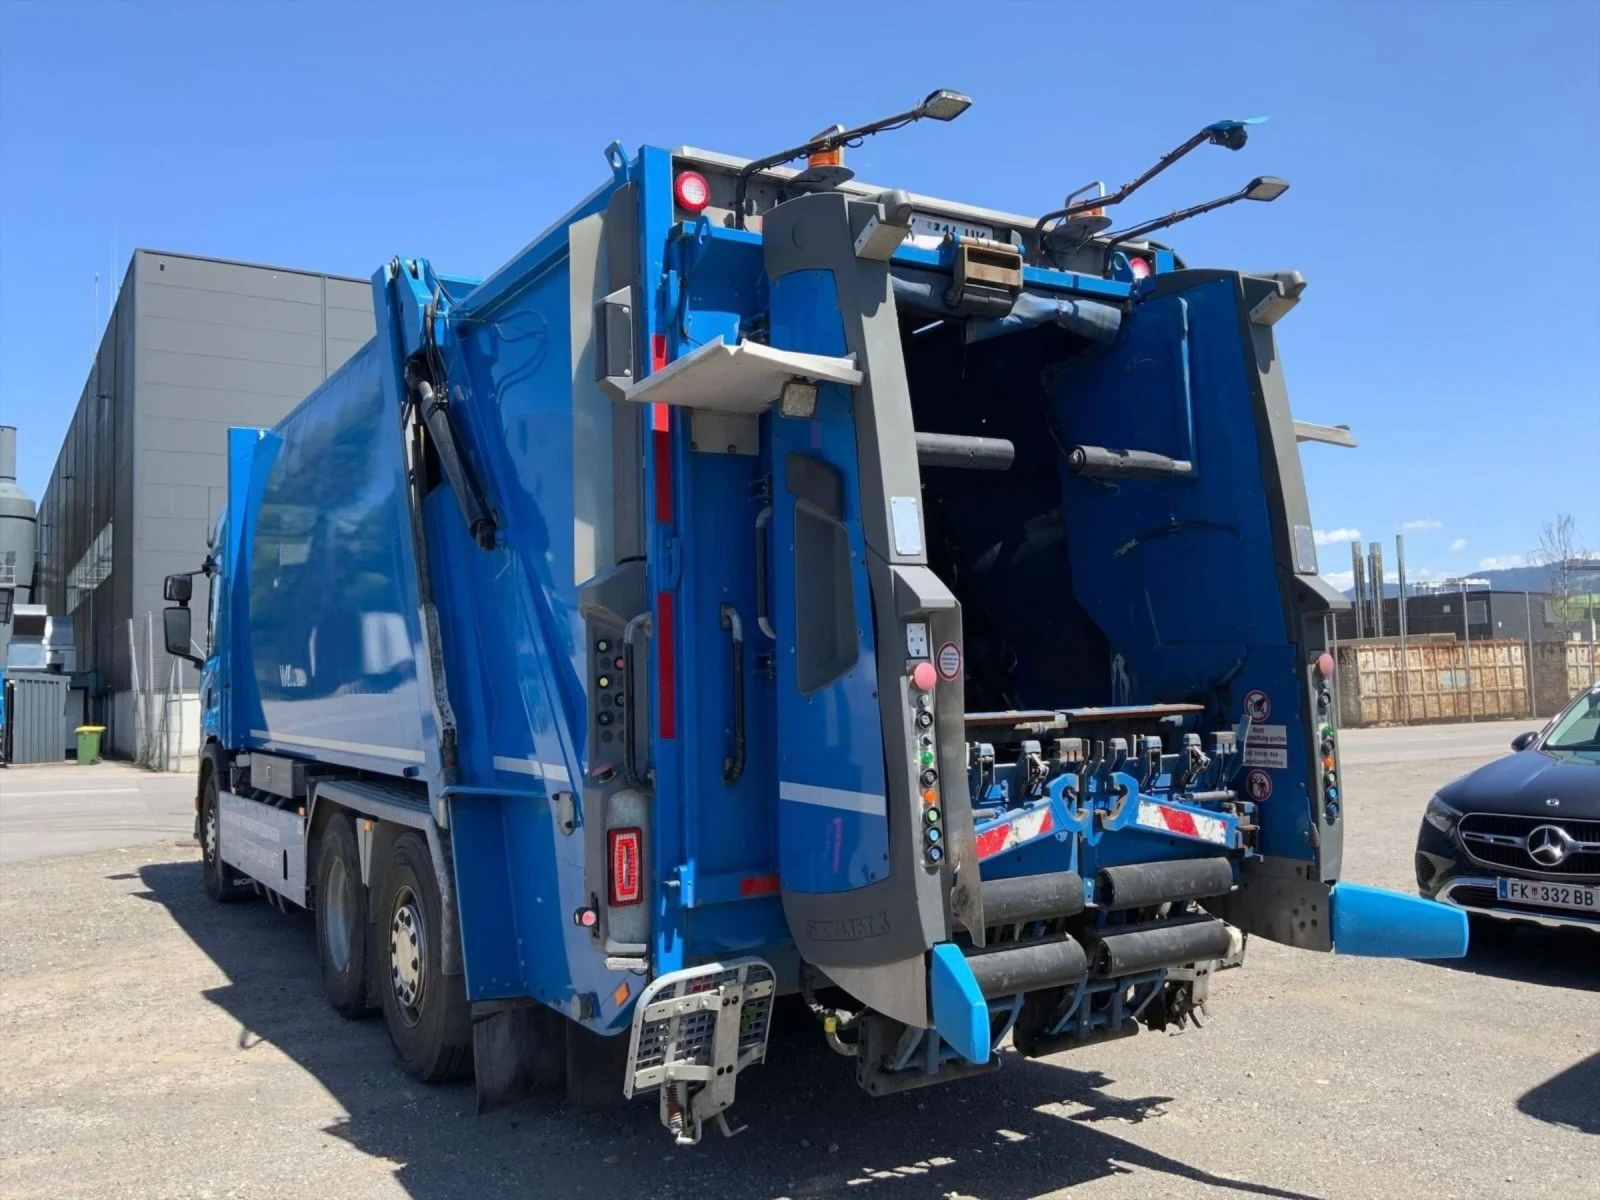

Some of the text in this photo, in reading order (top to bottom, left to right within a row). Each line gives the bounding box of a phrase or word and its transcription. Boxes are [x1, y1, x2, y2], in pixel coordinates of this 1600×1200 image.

[1511, 883, 1594, 906] FK 332 BB
